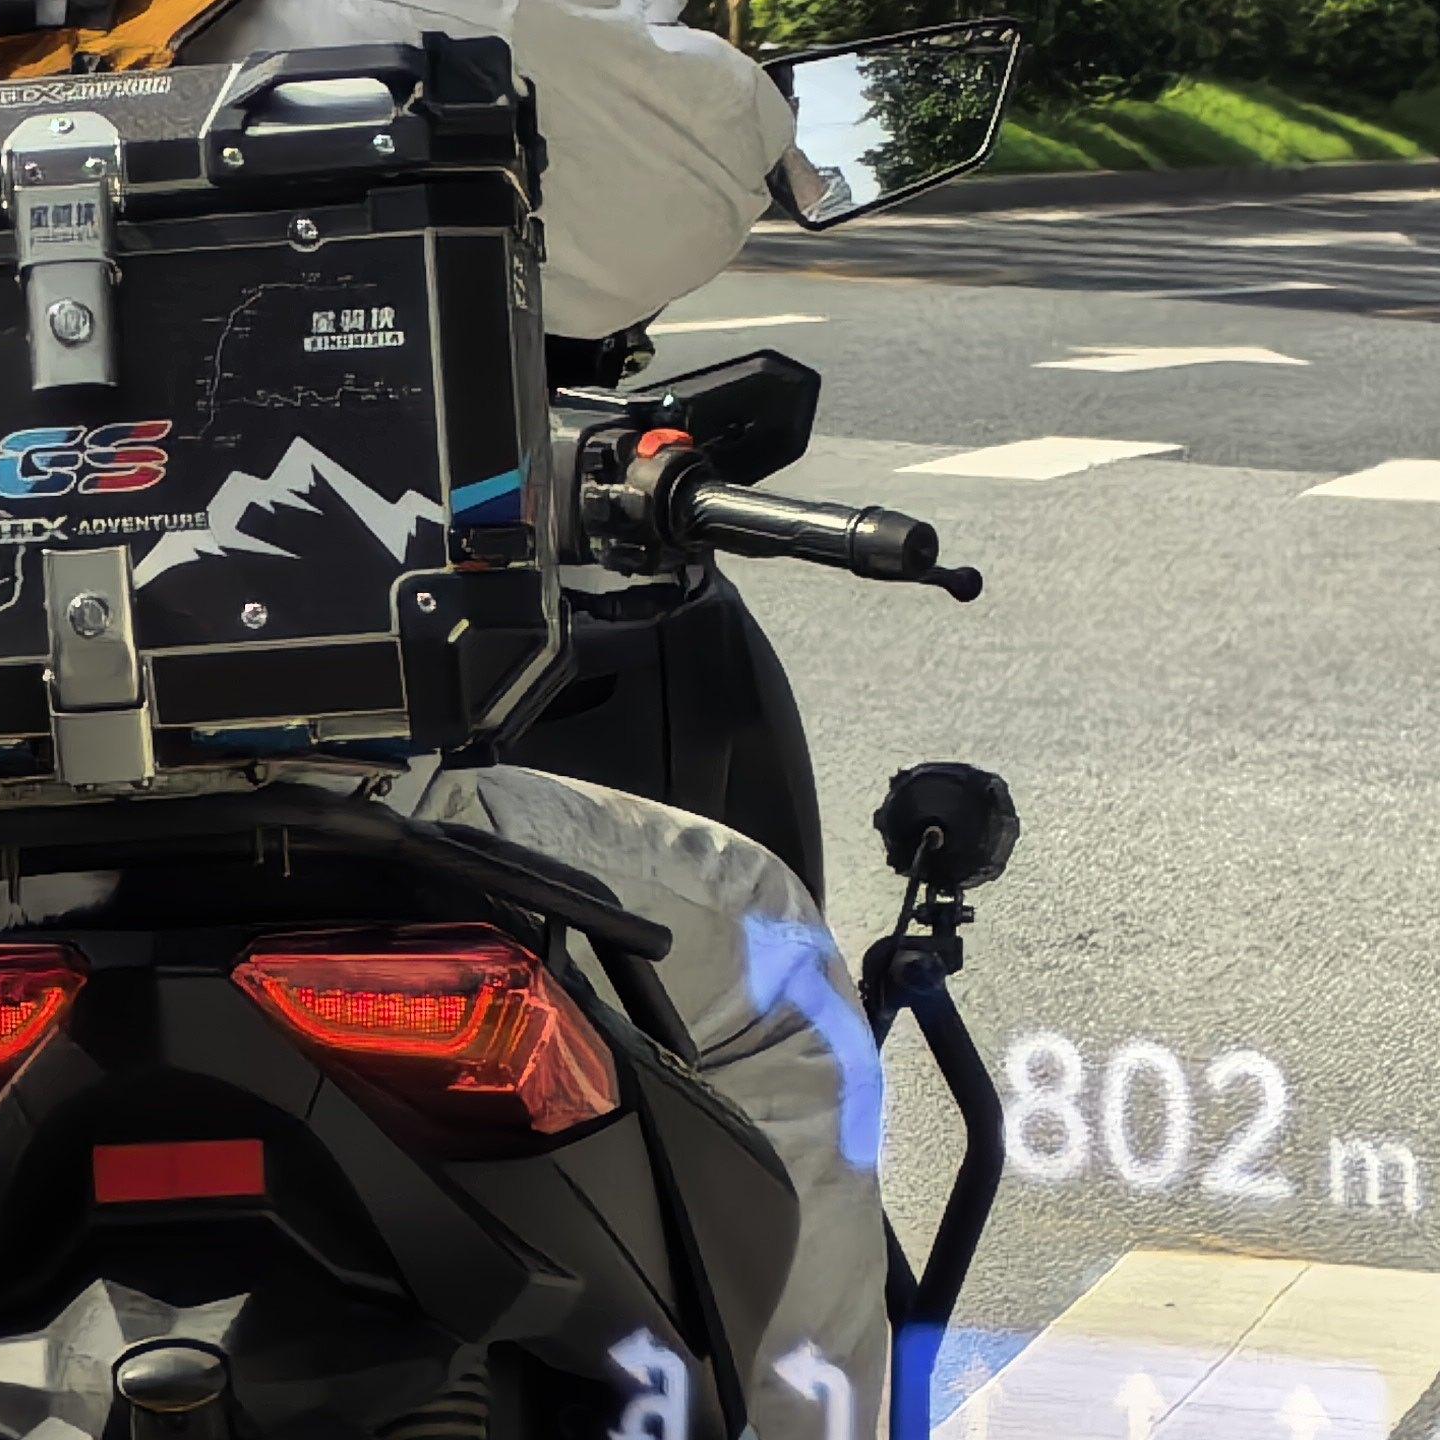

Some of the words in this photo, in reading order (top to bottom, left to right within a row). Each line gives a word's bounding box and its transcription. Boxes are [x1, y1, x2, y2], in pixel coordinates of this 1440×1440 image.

[76, 512, 209, 536] ADVENTURE
[1002, 1030, 1298, 1201] 802
[1329, 1135, 1421, 1218] m
